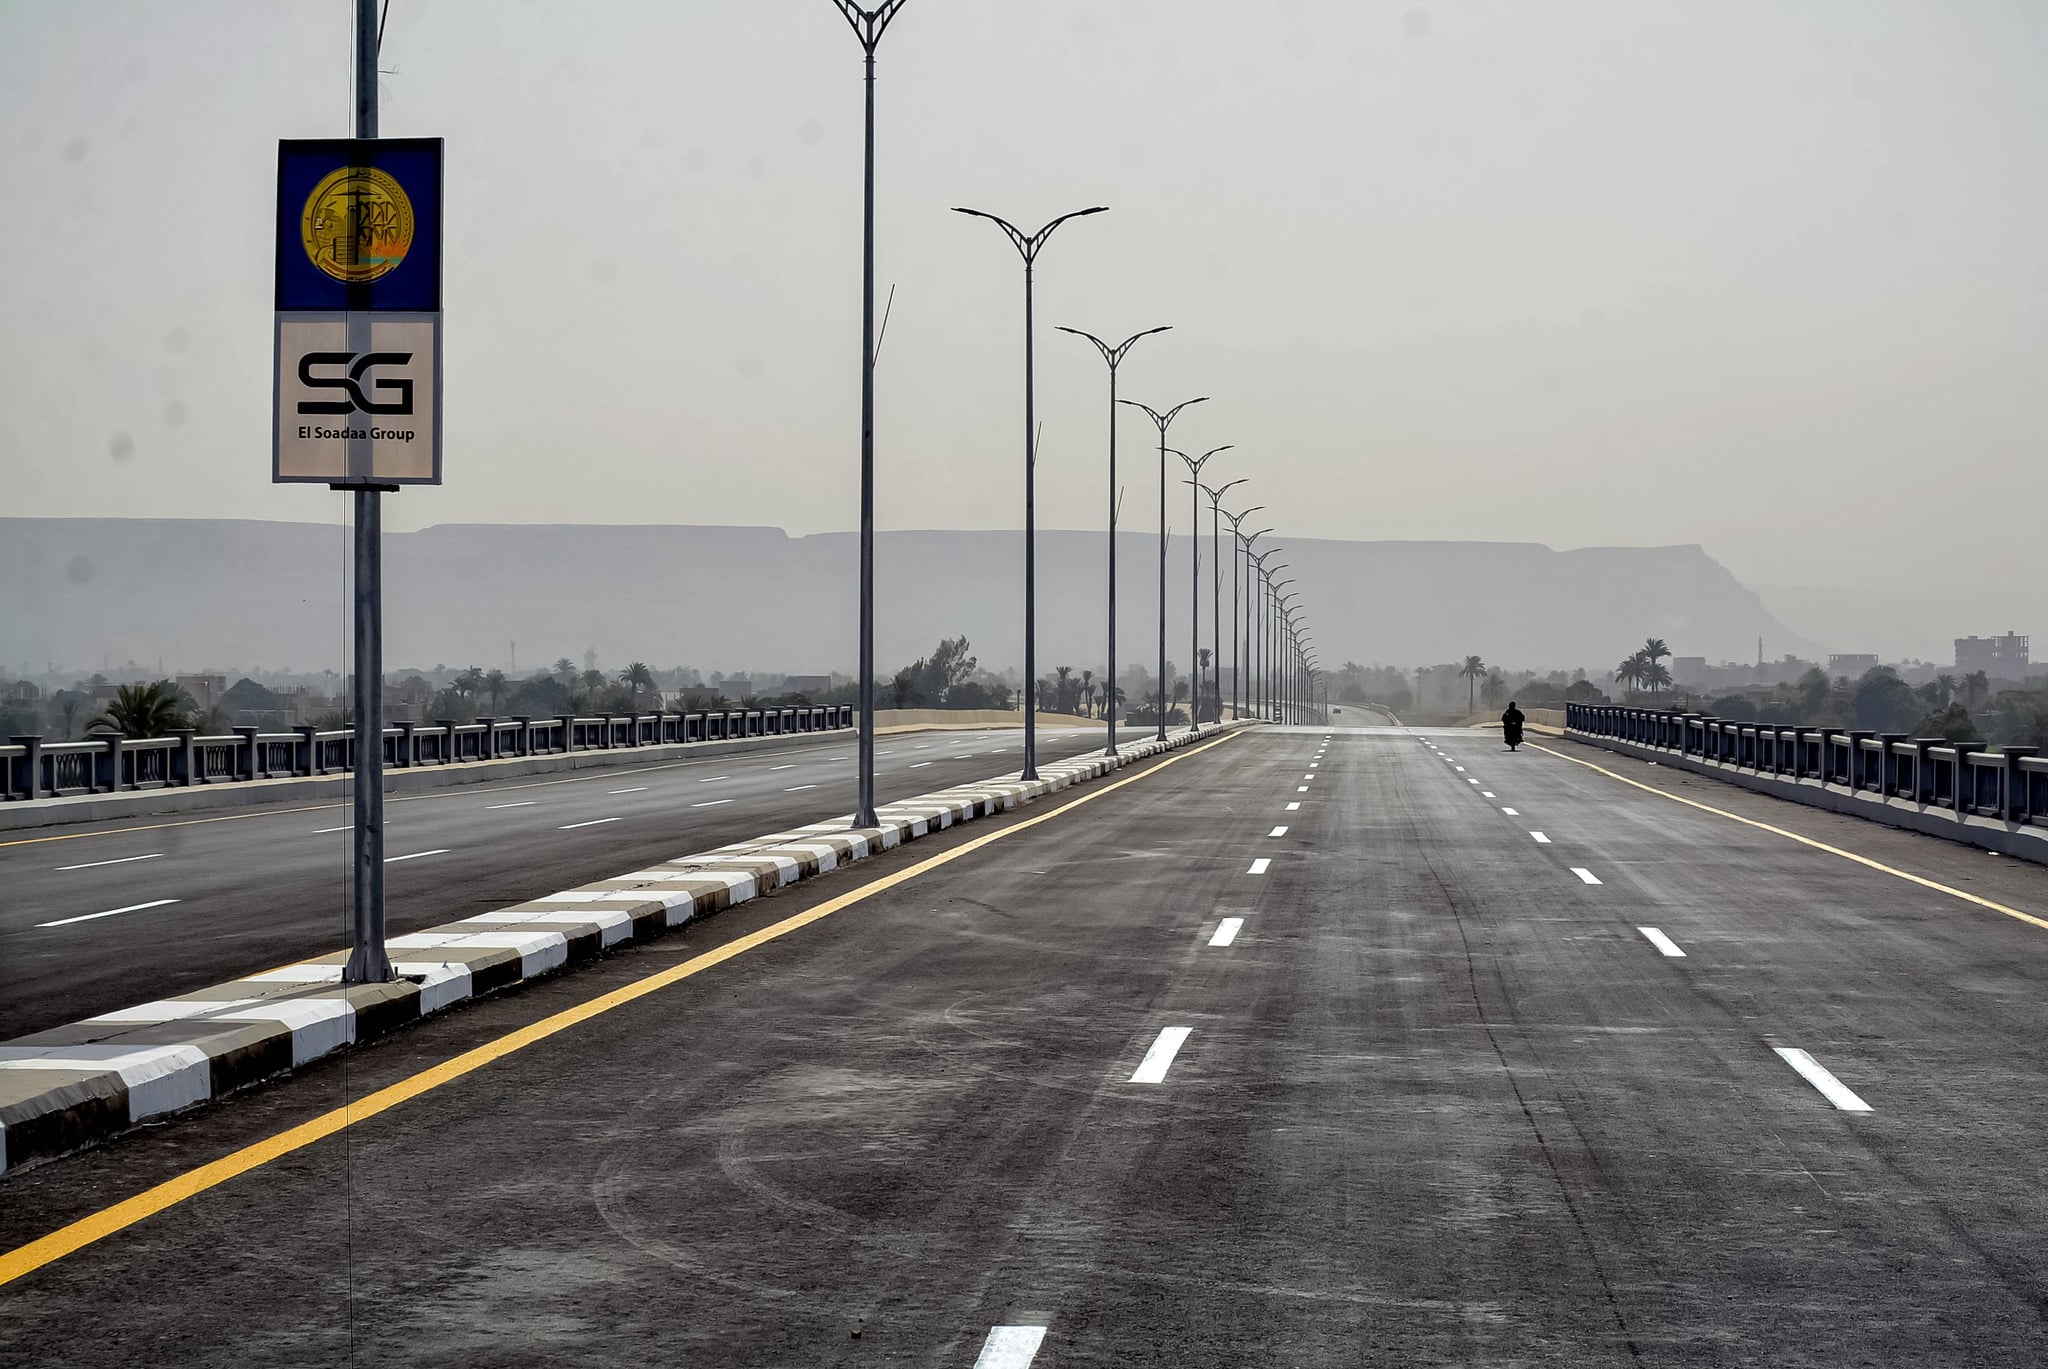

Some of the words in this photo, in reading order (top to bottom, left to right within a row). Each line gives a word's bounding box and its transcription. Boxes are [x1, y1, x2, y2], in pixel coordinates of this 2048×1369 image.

[297, 352, 414, 415] SG
[298, 426, 311, 439] El
[314, 426, 367, 440] Soadaa
[370, 427, 415, 443] Group
